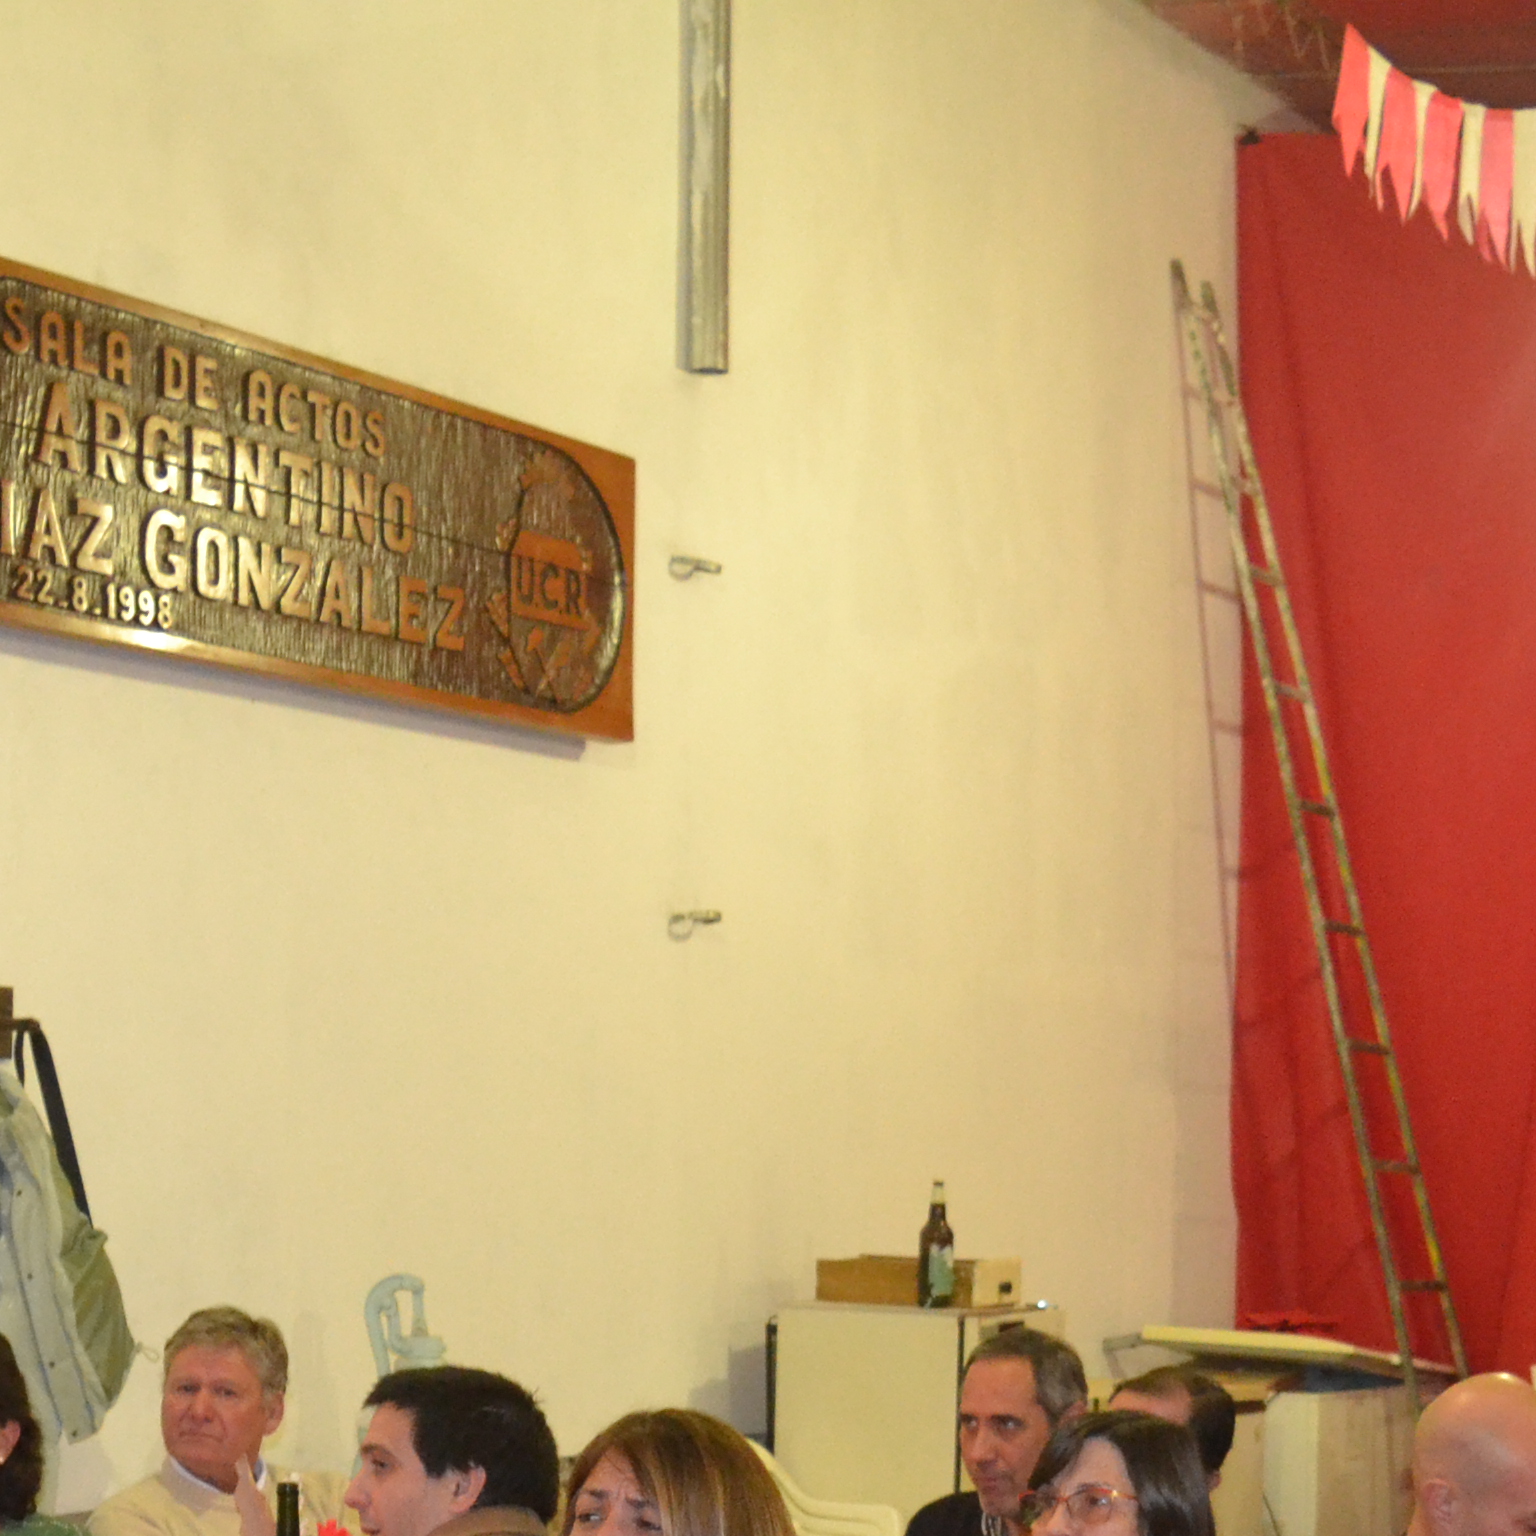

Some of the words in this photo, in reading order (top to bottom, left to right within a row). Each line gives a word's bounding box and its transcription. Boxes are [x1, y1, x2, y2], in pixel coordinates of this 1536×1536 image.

[2, 296, 133, 387] SALA
[162, 345, 220, 412] DE
[247, 368, 386, 459] ACTOS
[36, 381, 414, 555] ARGENTINO
[144, 508, 465, 652] GONZALEZ
